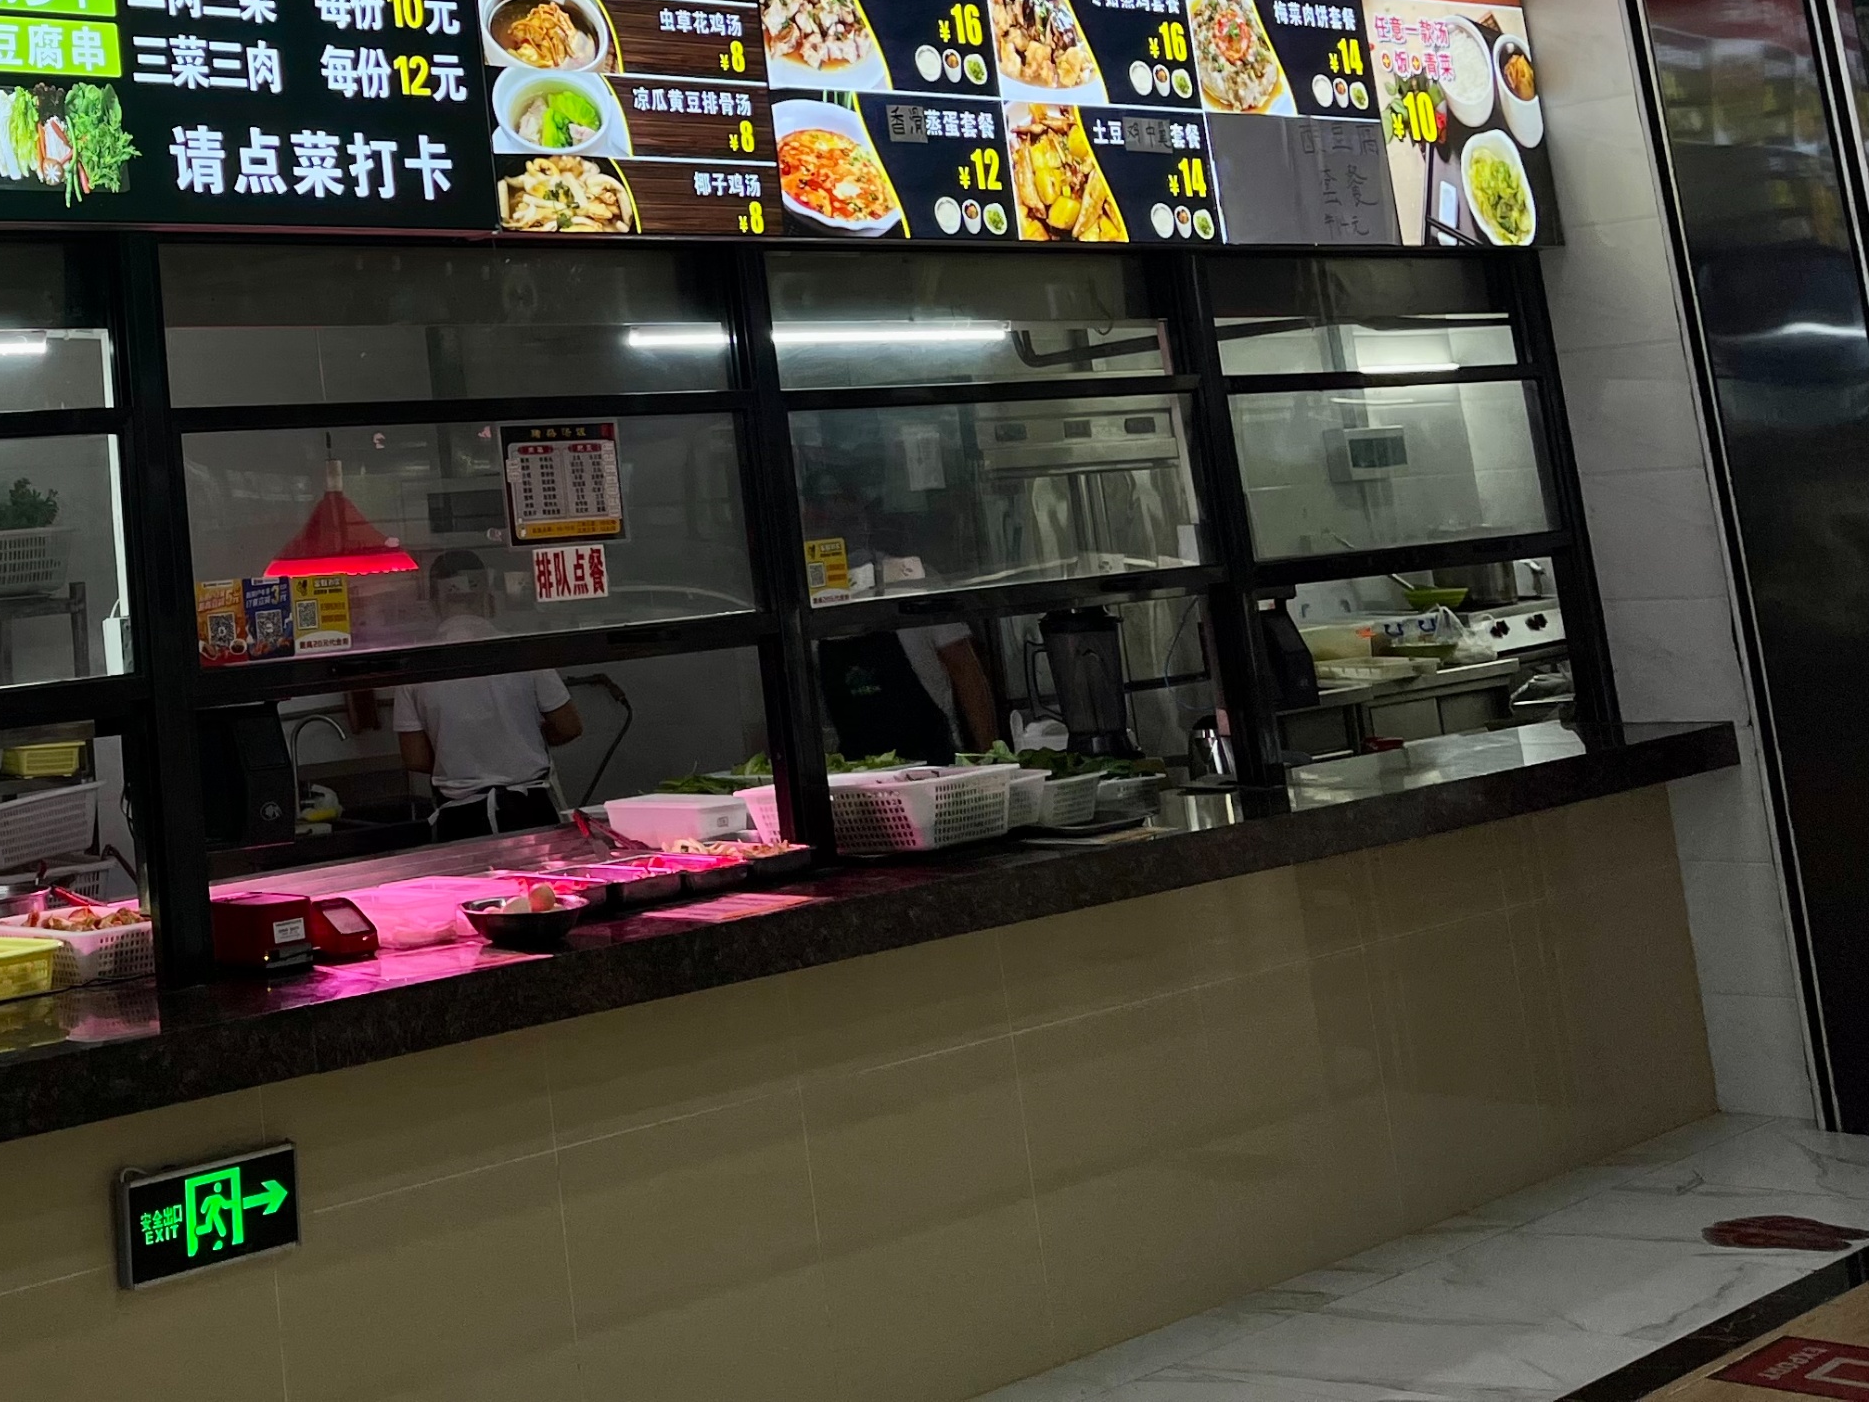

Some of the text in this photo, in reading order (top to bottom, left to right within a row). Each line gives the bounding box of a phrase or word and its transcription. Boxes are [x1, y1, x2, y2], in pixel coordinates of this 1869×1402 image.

[658, 8, 743, 38] 虫草花鸡汤
[938, 2, 984, 48] ¥16
[1272, 0, 1358, 33] 梅菜肉饼套餐
[1373, 14, 1452, 49] 任意一款汤
[1147, 21, 1188, 64] ¥16
[1328, 37, 1365, 77] ¥14
[132, 33, 468, 103] 三菜三肉 每份12元
[632, 86, 752, 117] 凉瓜黄豆排骨汤
[1390, 90, 1438, 144] ¥10
[168, 124, 454, 200] 请点菜打卡
[958, 147, 1004, 193] ¥12
[1167, 157, 1208, 199] ¥14
[693, 170, 762, 198] 椰子鸡汤
[534, 547, 607, 600] 排队点餐
[140, 1205, 183, 1231] 安全出口
[145, 1224, 179, 1245] EXIT
